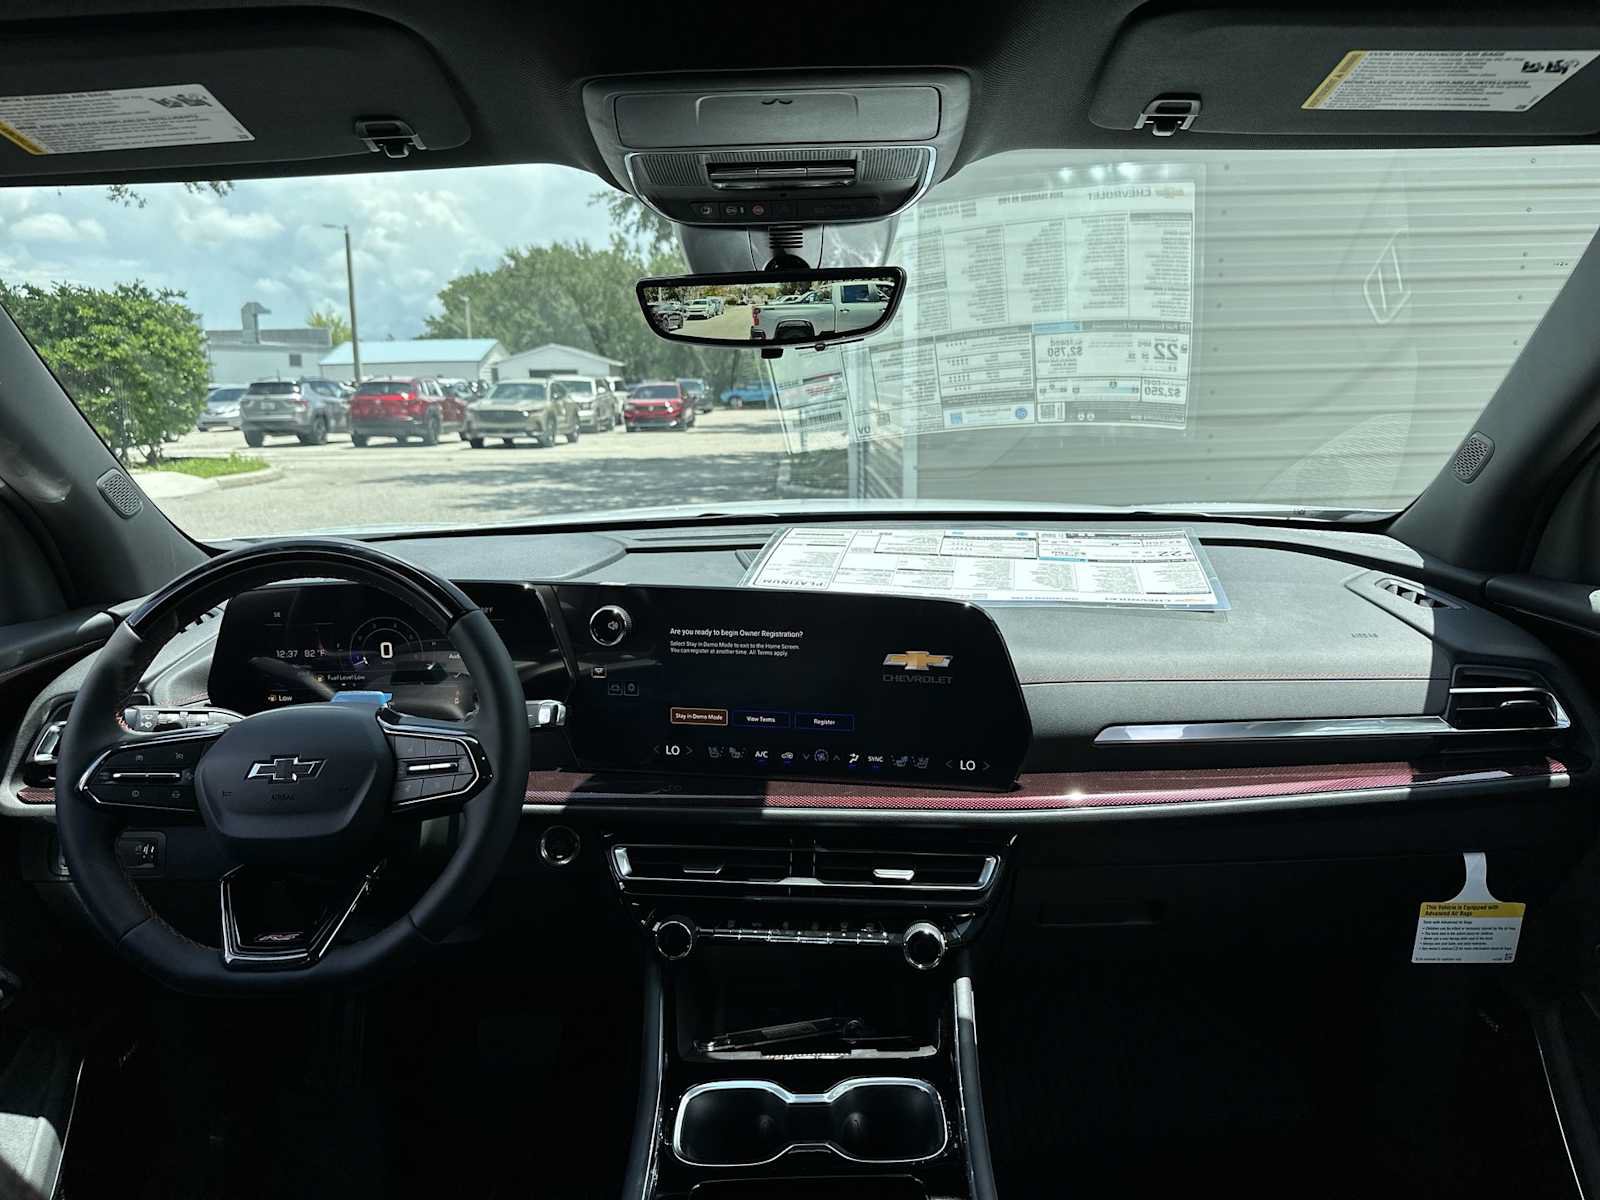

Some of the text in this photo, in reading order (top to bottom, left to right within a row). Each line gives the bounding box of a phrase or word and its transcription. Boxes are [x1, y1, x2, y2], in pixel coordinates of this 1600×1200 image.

[695, 628, 712, 637] ready
[721, 629, 739, 637] begin
[740, 629, 760, 637] Owner
[761, 630, 804, 638] Registration?
[275, 649, 298, 658] 12:37
[380, 641, 394, 659] 0
[327, 673, 339, 681] Fuel
[882, 674, 953, 684] CHEVROLET
[675, 712, 686, 721] Stay
[813, 718, 836, 726] Register
[665, 745, 680, 756] LO
[755, 750, 769, 759] A/C
[867, 755, 884, 763] SYNC
[959, 760, 976, 771] LO
